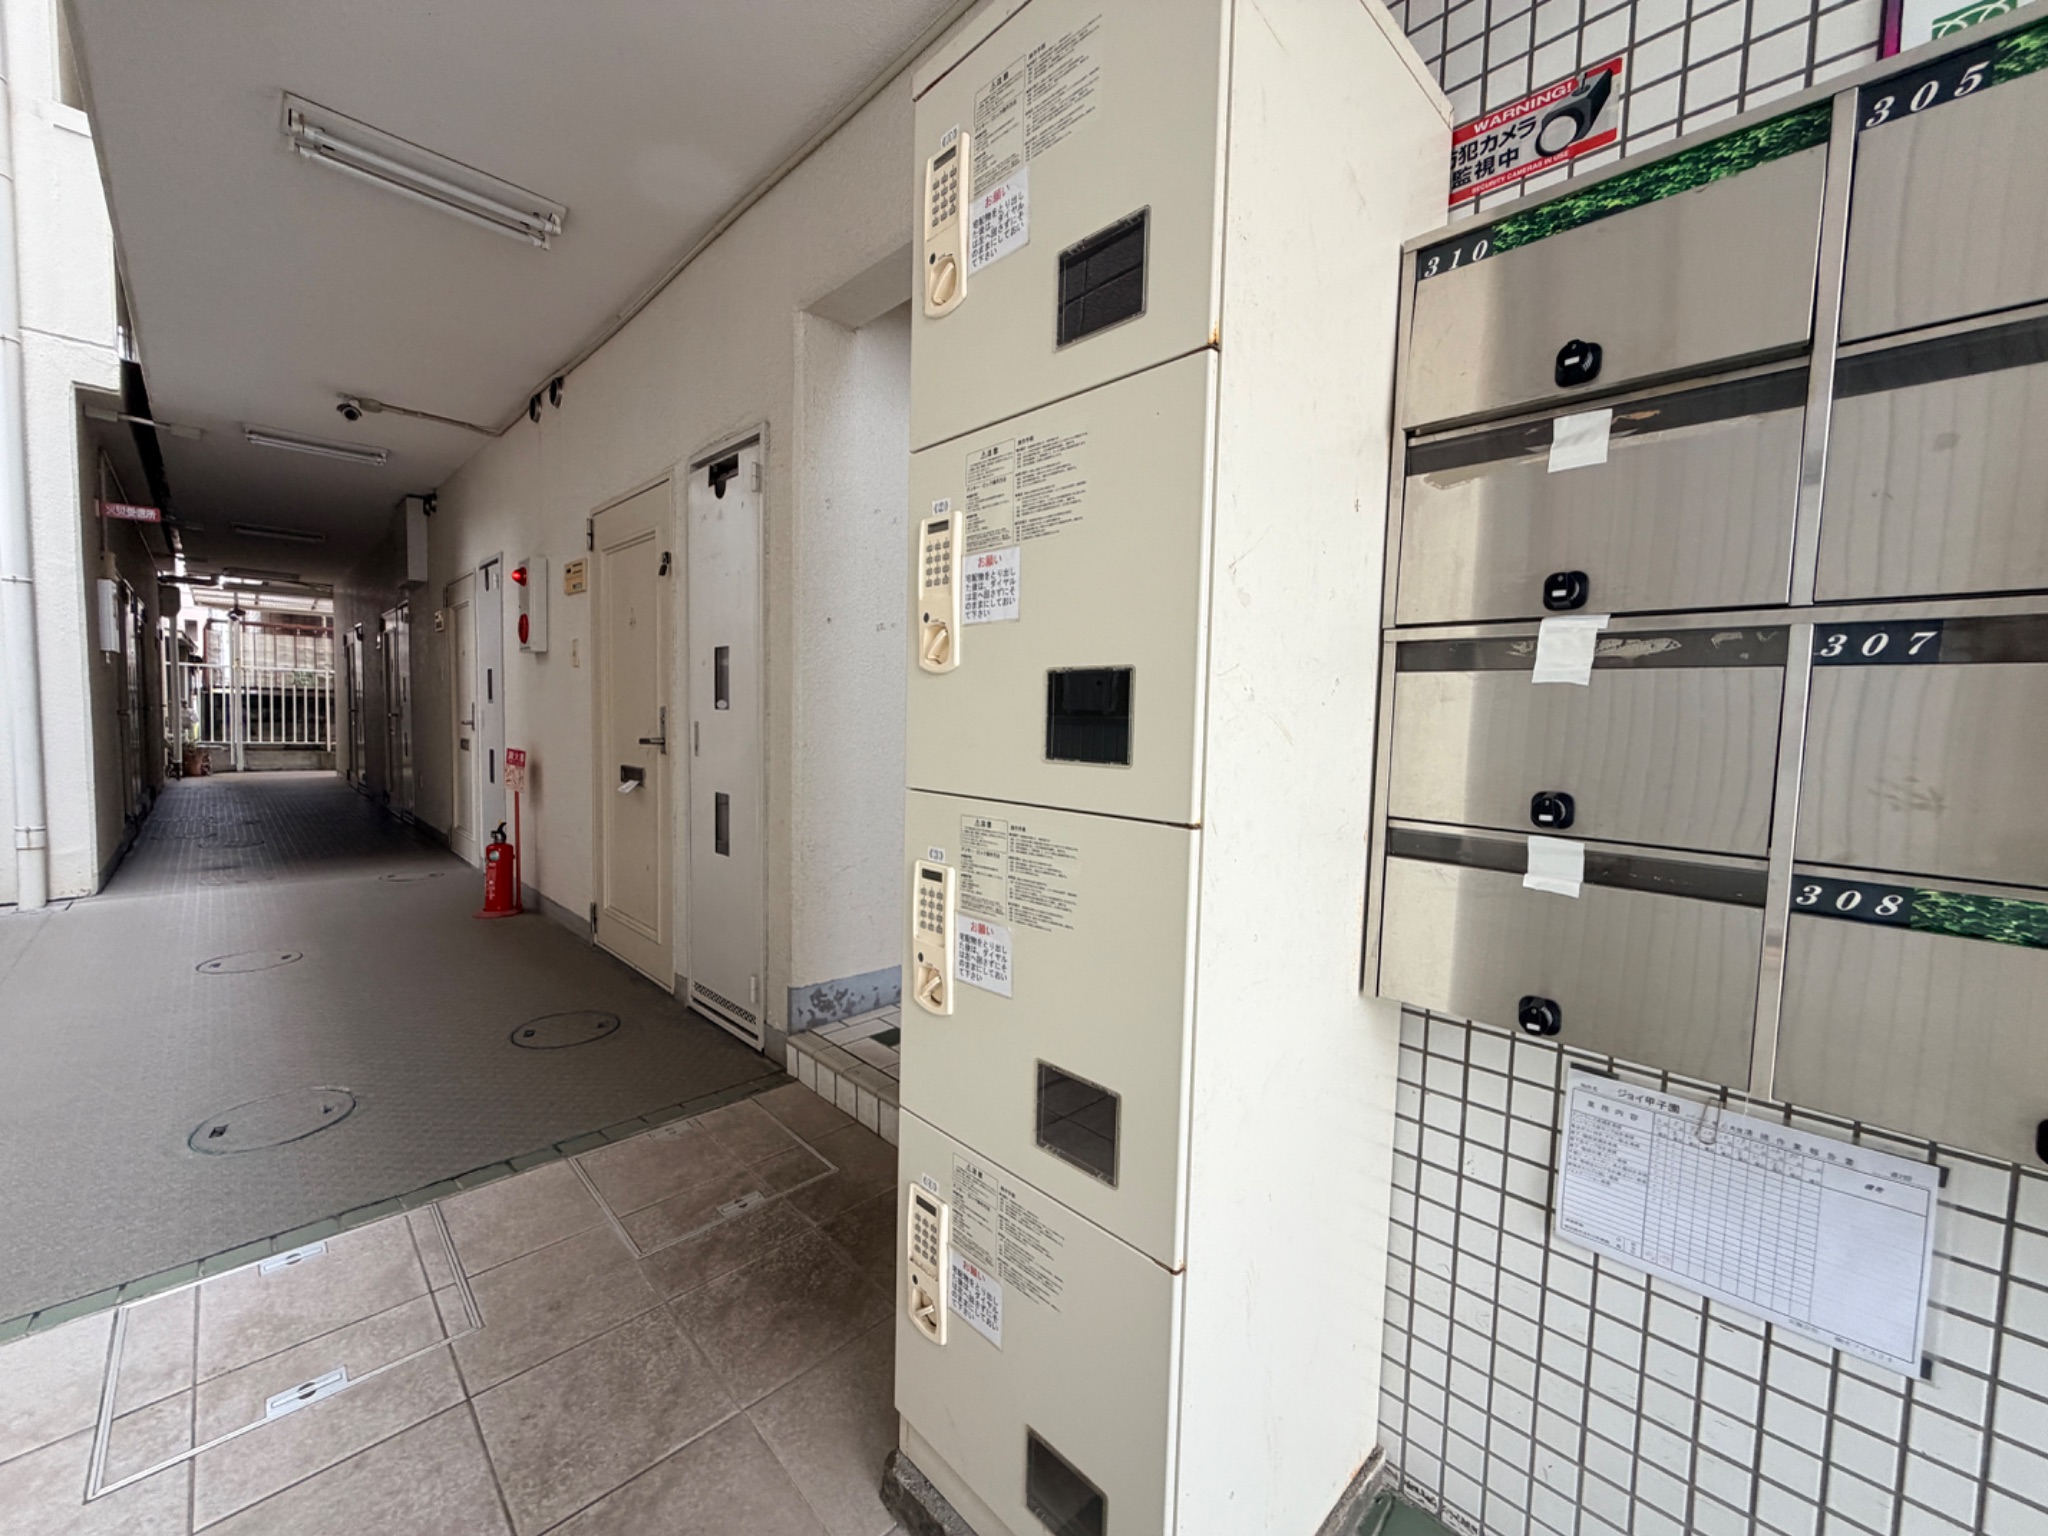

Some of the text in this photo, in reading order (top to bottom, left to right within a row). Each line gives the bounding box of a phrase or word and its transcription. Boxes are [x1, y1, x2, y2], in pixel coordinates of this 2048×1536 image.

[1473, 81, 1573, 134] WARNING!
[1451, 147, 1520, 190] 監視中
[1471, 150, 1570, 194] SECURITY CAMERAS IN USE
[985, 184, 1010, 208] お願い
[978, 554, 1002, 568] お願い
[965, 610, 990, 619] て下さい
[970, 921, 995, 935] お願い
[1617, 1088, 1680, 1114] ジョイ甲子園
